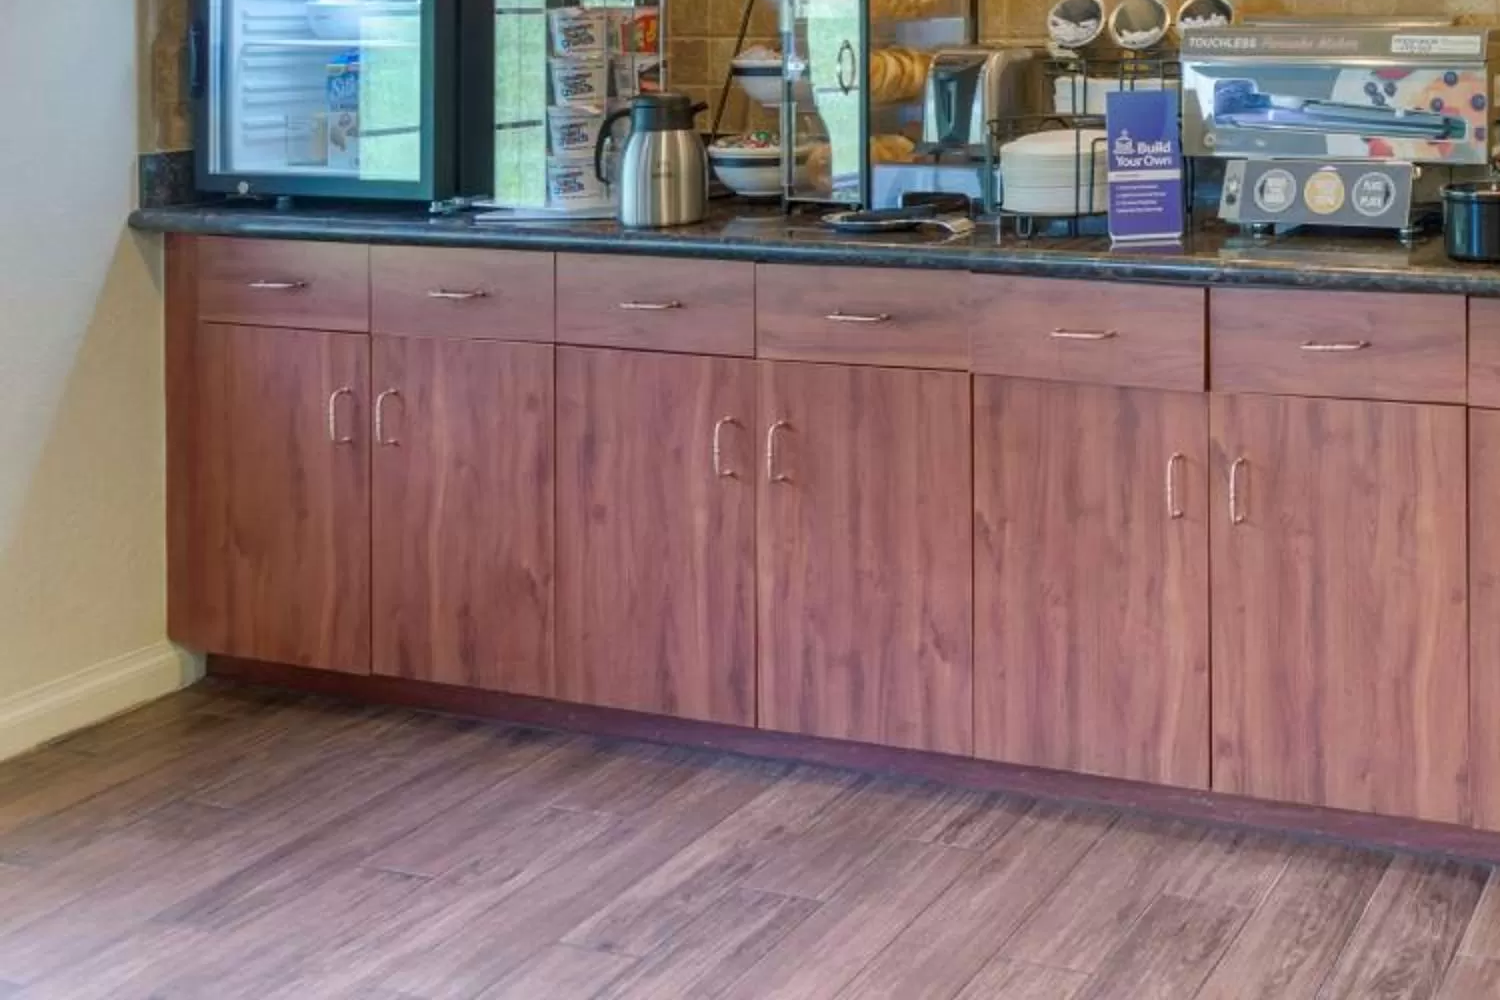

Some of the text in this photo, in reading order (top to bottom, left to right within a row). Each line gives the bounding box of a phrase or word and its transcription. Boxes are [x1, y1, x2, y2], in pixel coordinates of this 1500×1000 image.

[1137, 140, 1172, 155] Build
[1115, 153, 1173, 167] Your Own
